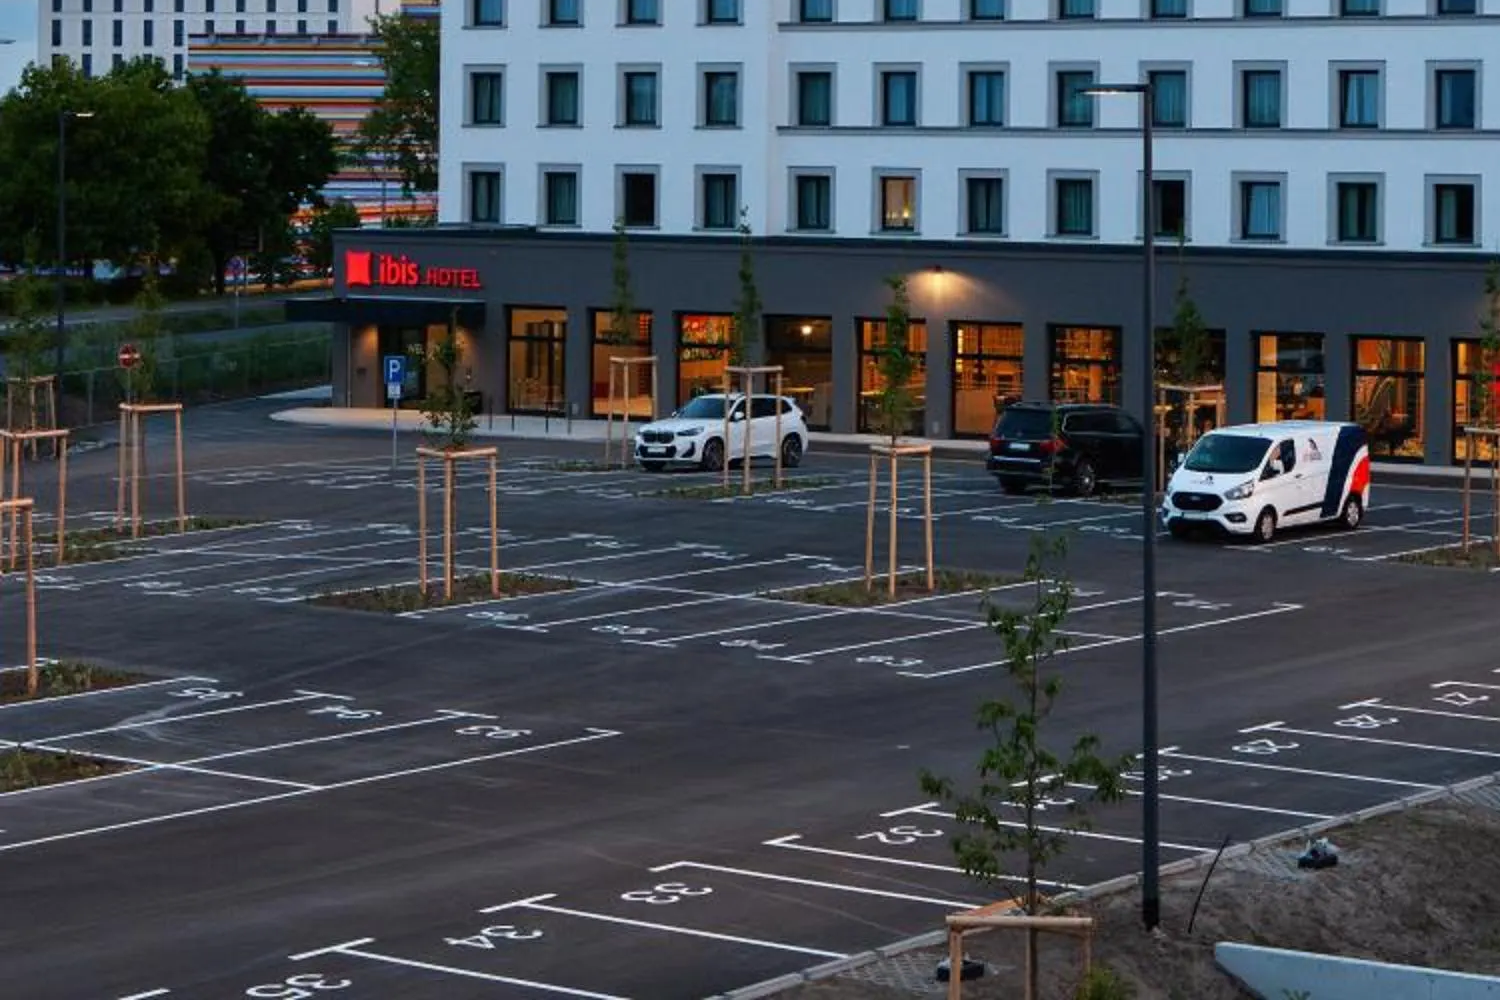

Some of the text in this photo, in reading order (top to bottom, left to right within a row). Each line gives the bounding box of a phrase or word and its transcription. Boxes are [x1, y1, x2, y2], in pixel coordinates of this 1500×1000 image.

[379, 255, 481, 288] ibis HOTEL
[389, 359, 401, 380] P
[1434, 692, 1489, 706] 27
[1334, 714, 1398, 728] 28
[1232, 739, 1299, 754] 29
[857, 826, 943, 844] 32
[621, 883, 712, 903] 33
[444, 925, 542, 949] 34
[246, 974, 351, 1000] 35
